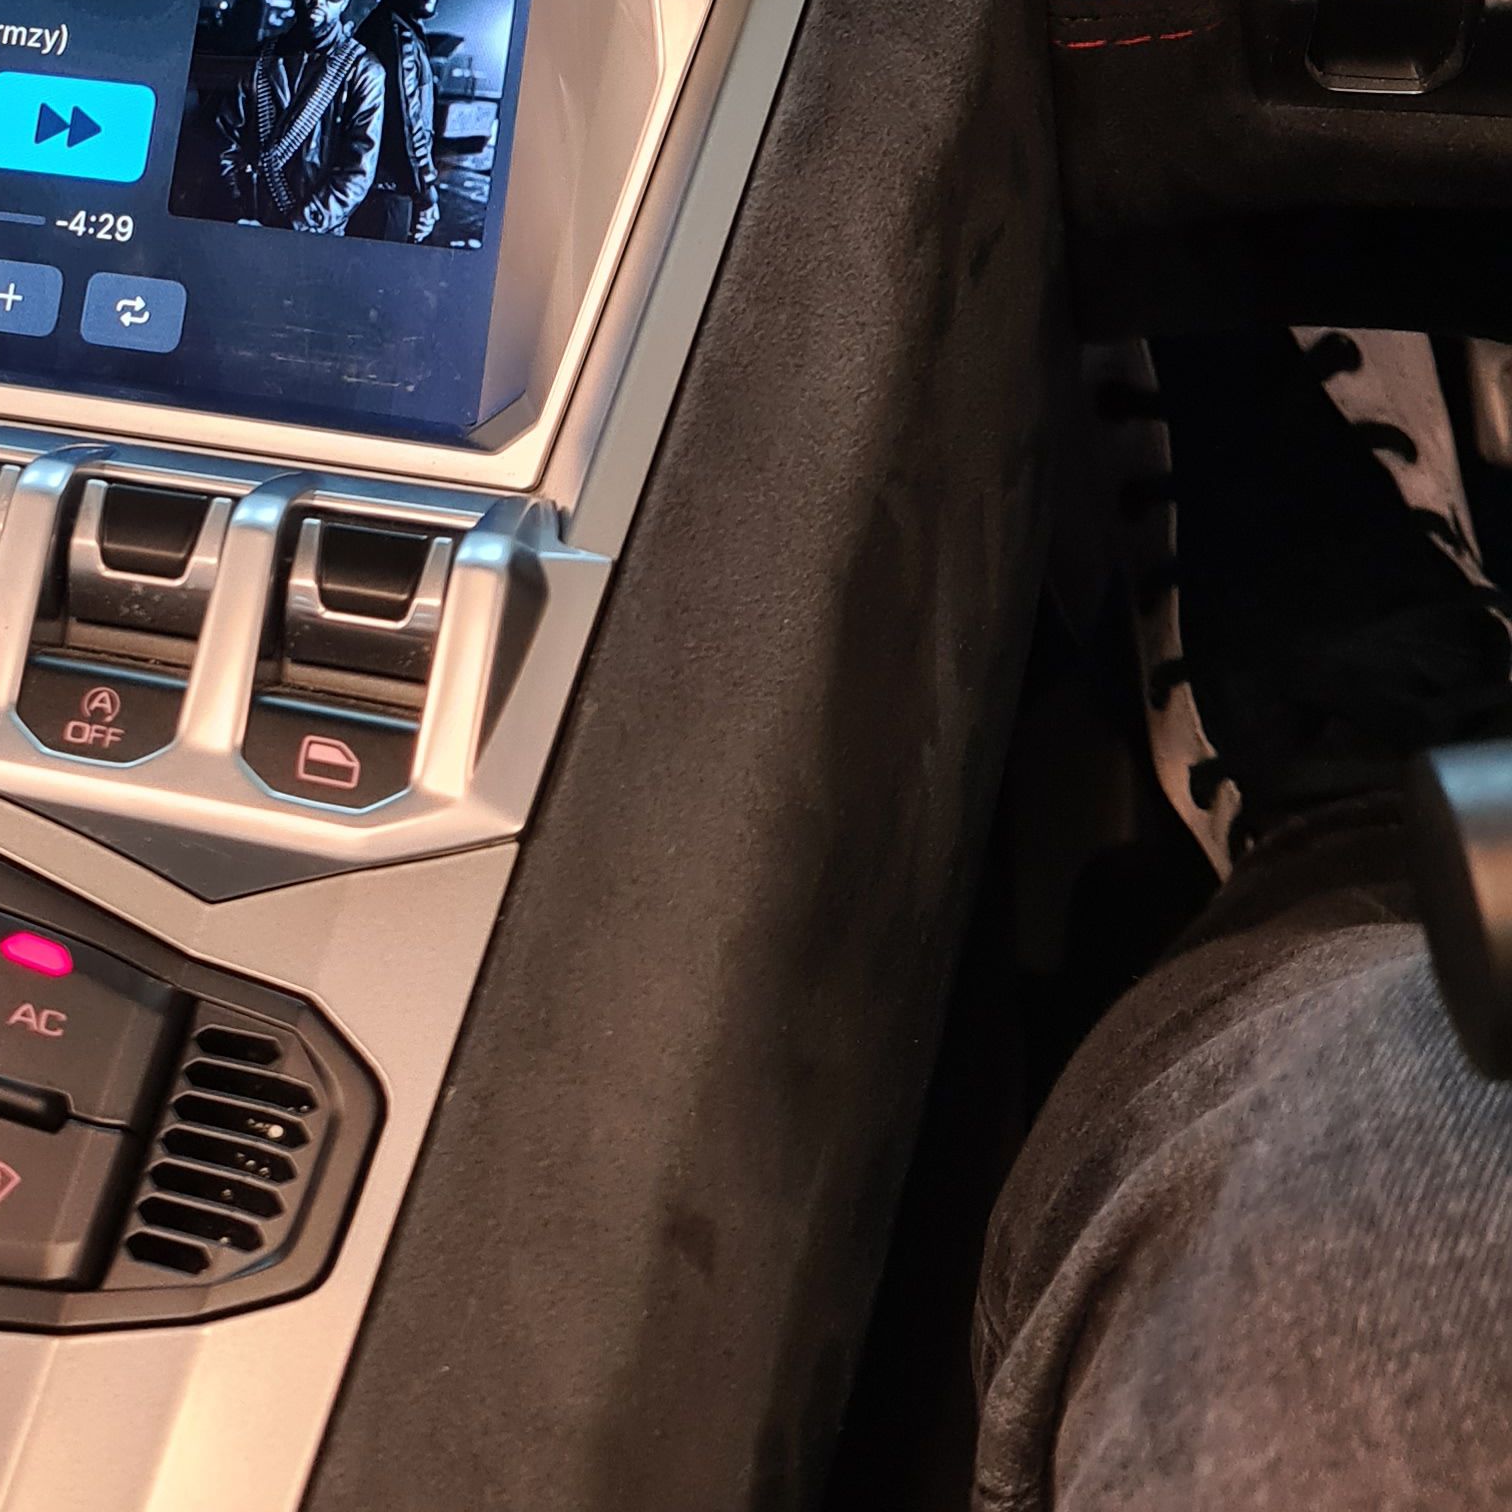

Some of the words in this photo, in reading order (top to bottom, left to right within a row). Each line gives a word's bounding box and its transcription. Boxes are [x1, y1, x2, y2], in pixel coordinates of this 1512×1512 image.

[55, 212, 135, 243] -4:29
[64, 720, 125, 747] OFF
[6, 1002, 67, 1037] AC
